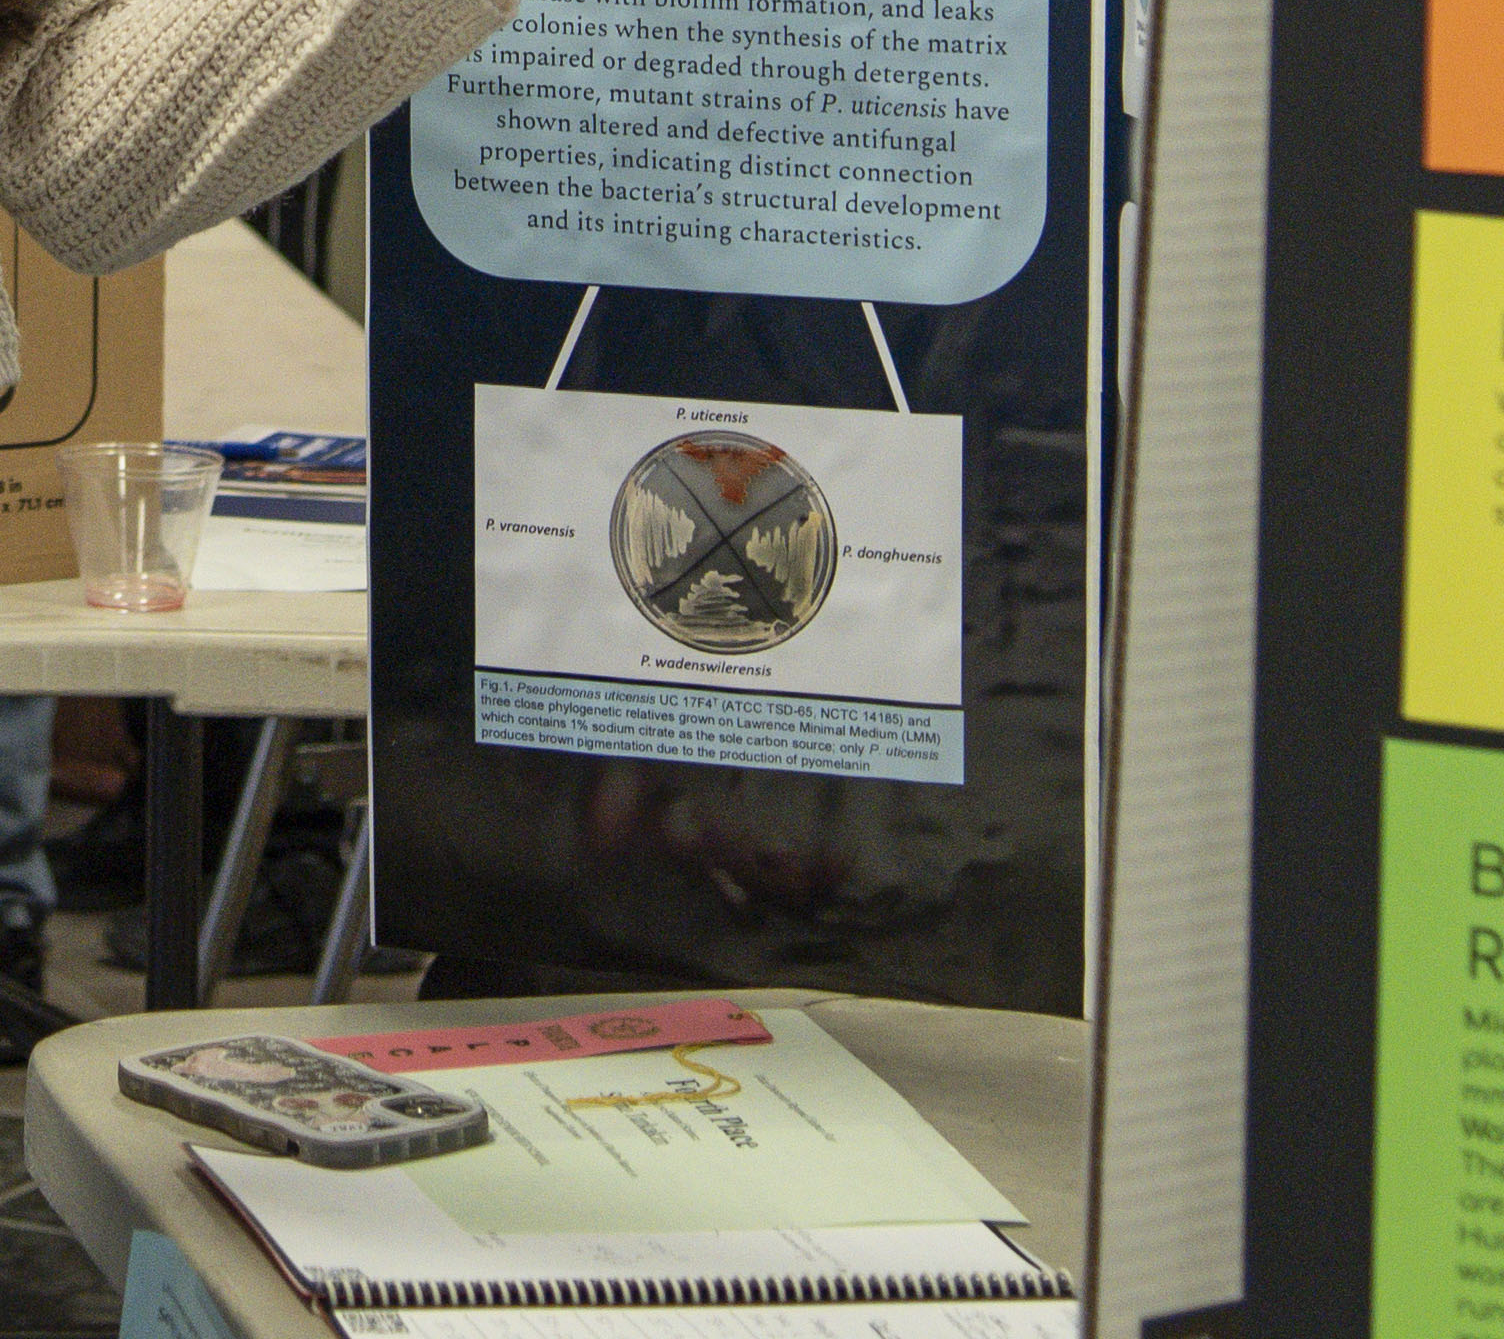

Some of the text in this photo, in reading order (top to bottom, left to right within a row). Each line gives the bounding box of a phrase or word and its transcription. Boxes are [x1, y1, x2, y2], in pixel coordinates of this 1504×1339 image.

[448, 73, 1010, 122] Furthermore, mutant strains of P. uticensis have
[453, 167, 549, 196] between
[557, 175, 593, 199] the
[721, 190, 837, 212] structural
[845, 191, 1001, 223] development
[527, 209, 922, 251] and its intriguing characteristics.
[485, 517, 575, 539] P. vranovensis
[842, 544, 942, 565] P. donghuensis
[640, 654, 650, 667] P.
